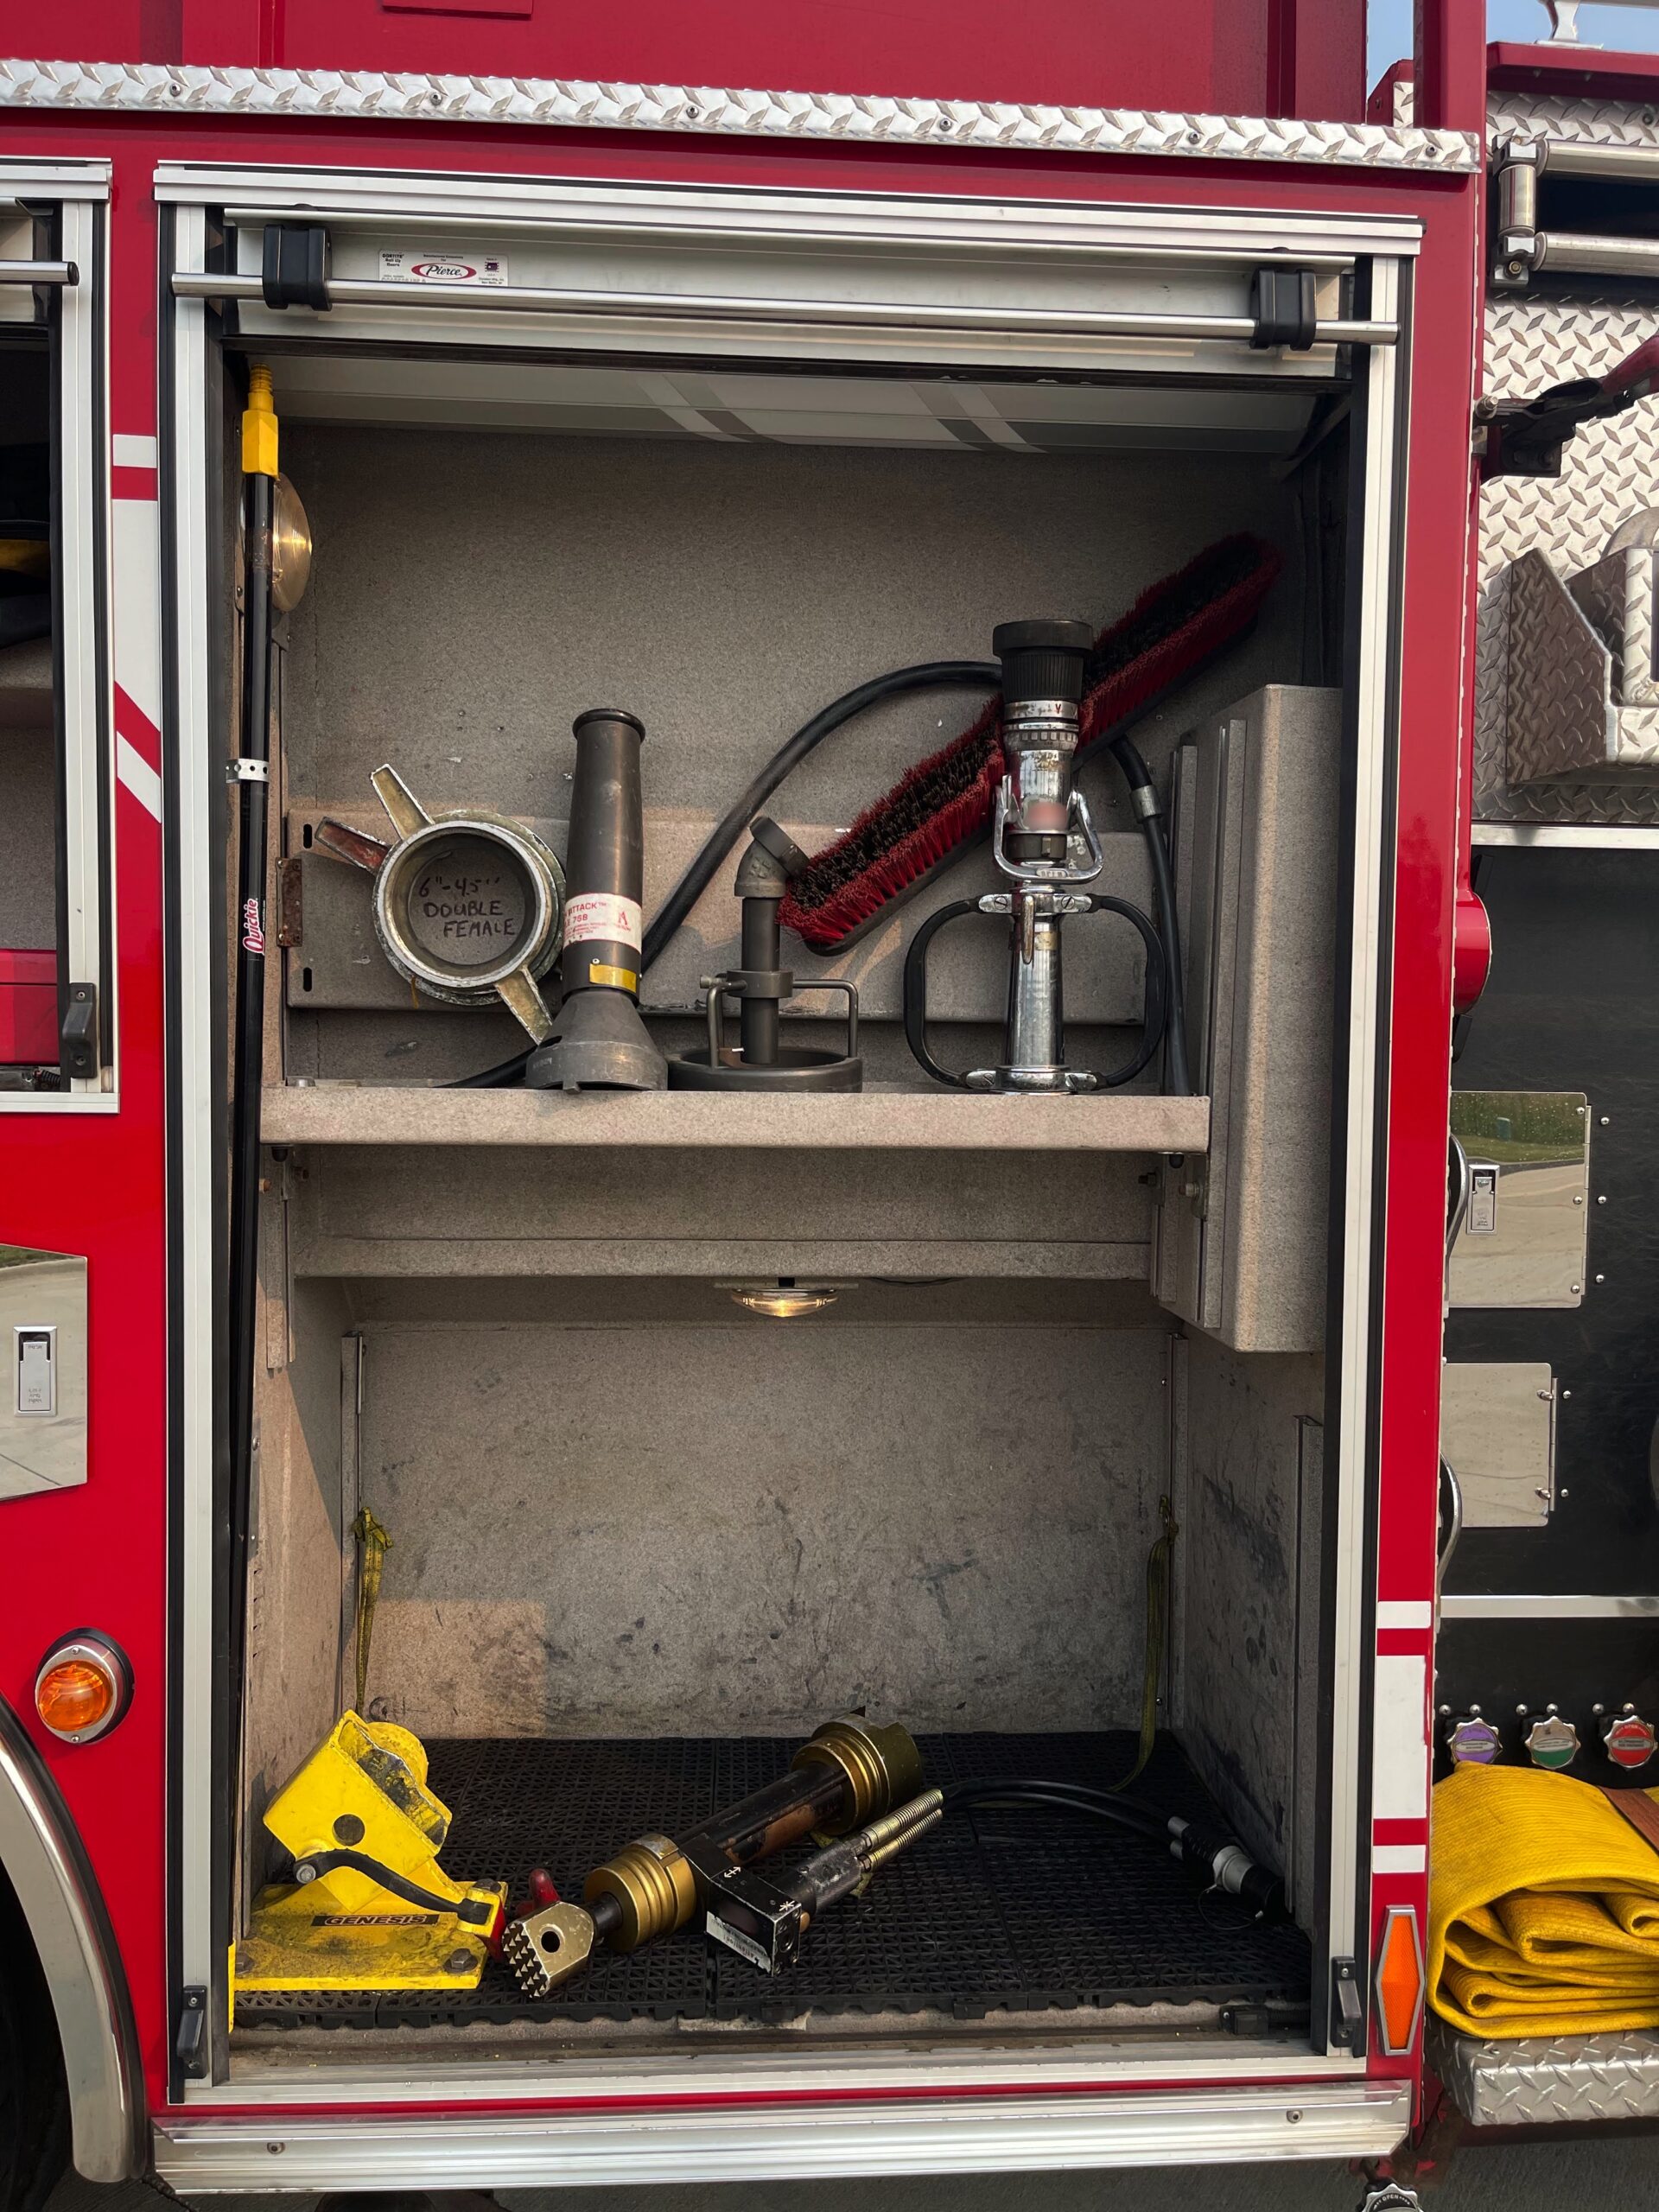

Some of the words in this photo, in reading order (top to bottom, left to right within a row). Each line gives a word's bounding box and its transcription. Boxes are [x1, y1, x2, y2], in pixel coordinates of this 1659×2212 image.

[426, 264, 461, 276] Pierce
[423, 900, 503, 918] DOUBLE
[243, 899, 264, 954] Quickie
[443, 918, 515, 938] FEMALE
[325, 1915, 427, 1926] GENESIS
